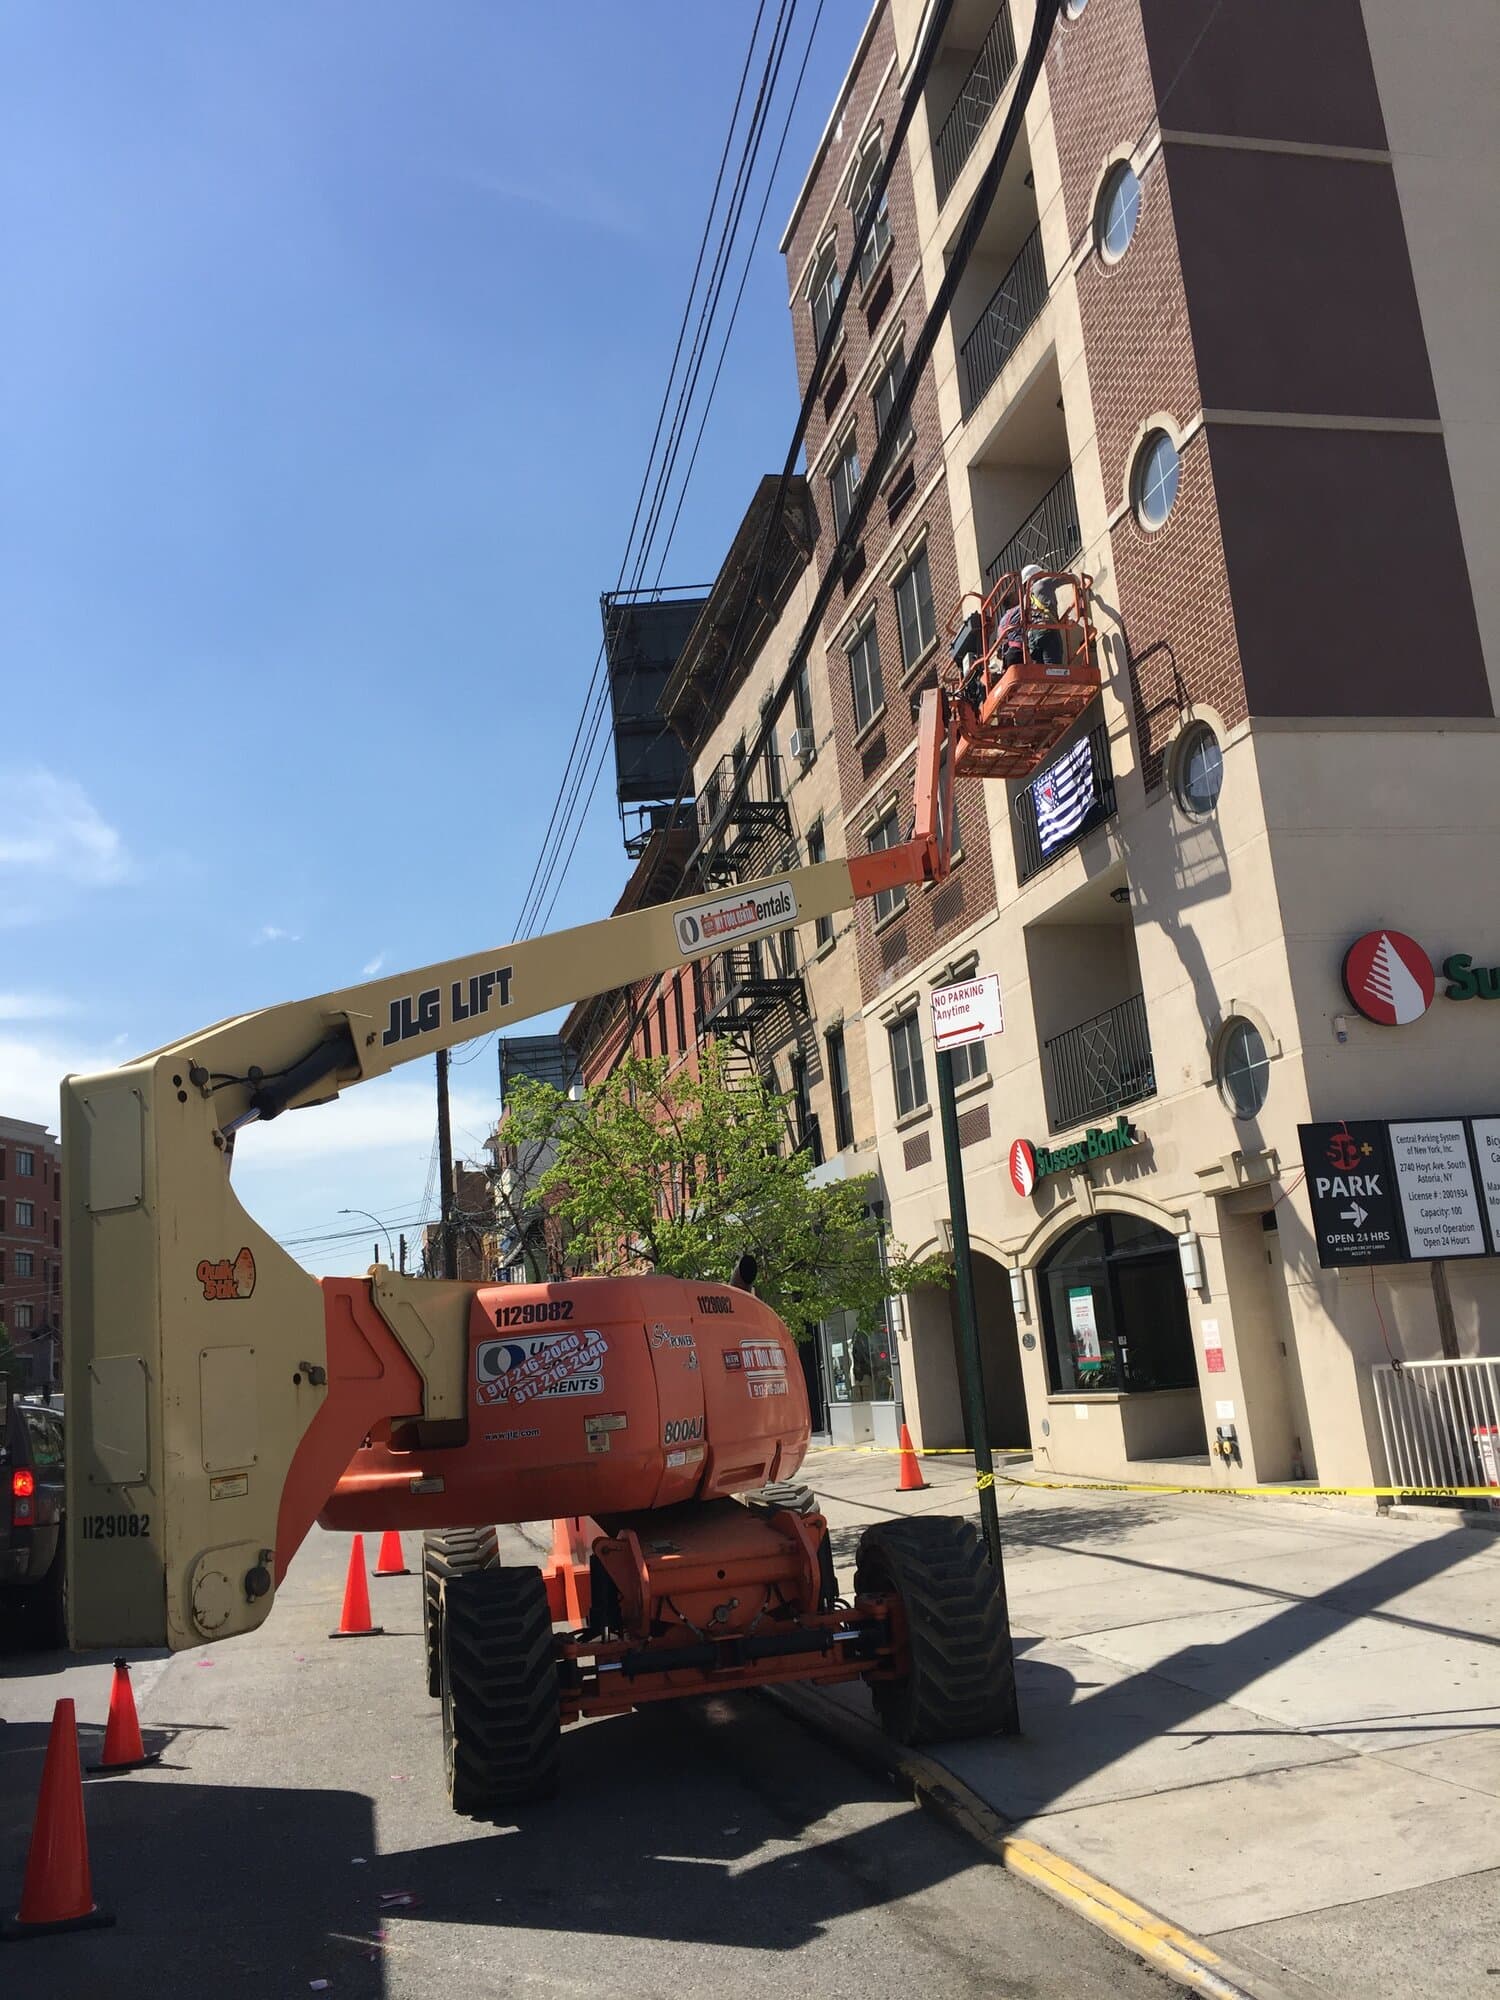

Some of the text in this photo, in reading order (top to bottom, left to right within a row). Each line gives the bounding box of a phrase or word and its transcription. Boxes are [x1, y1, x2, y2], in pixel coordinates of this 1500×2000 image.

[934, 984, 984, 1007] NO PARKING
[382, 966, 512, 1047] JLG LIFT
[936, 1004, 970, 1020] Anytime
[1036, 1115, 1136, 1177] Sussex Bank
[1396, 1133, 1460, 1144] Central Parking System
[1407, 1147, 1413, 1155] of
[1414, 1146, 1427, 1154] New
[1427, 1146, 1442, 1155] York,
[1400, 1160, 1466, 1173] 2740 Hoyt Ave. South
[1316, 1174, 1382, 1198] PARK
[1417, 1173, 1453, 1184] Astoria, NY
[1408, 1192, 1433, 1201] License
[1443, 1189, 1468, 1199] 2001934
[1420, 1206, 1463, 1220] Capacity: 100
[1414, 1223, 1475, 1235] Hours of Operation
[1326, 1231, 1390, 1244] OPEN 24 HRS
[1423, 1236, 1470, 1248] Open 24 Hours
[697, 1296, 734, 1314] 1129082
[495, 1301, 573, 1327] 1129082
[486, 1334, 580, 1398] 917-216-2040
[514, 1340, 609, 1404] 917-216-2040
[484, 1429, 540, 1441] www.jlg.com
[664, 1416, 703, 1445] 800AJ
[83, 1514, 150, 1539] 1129082
